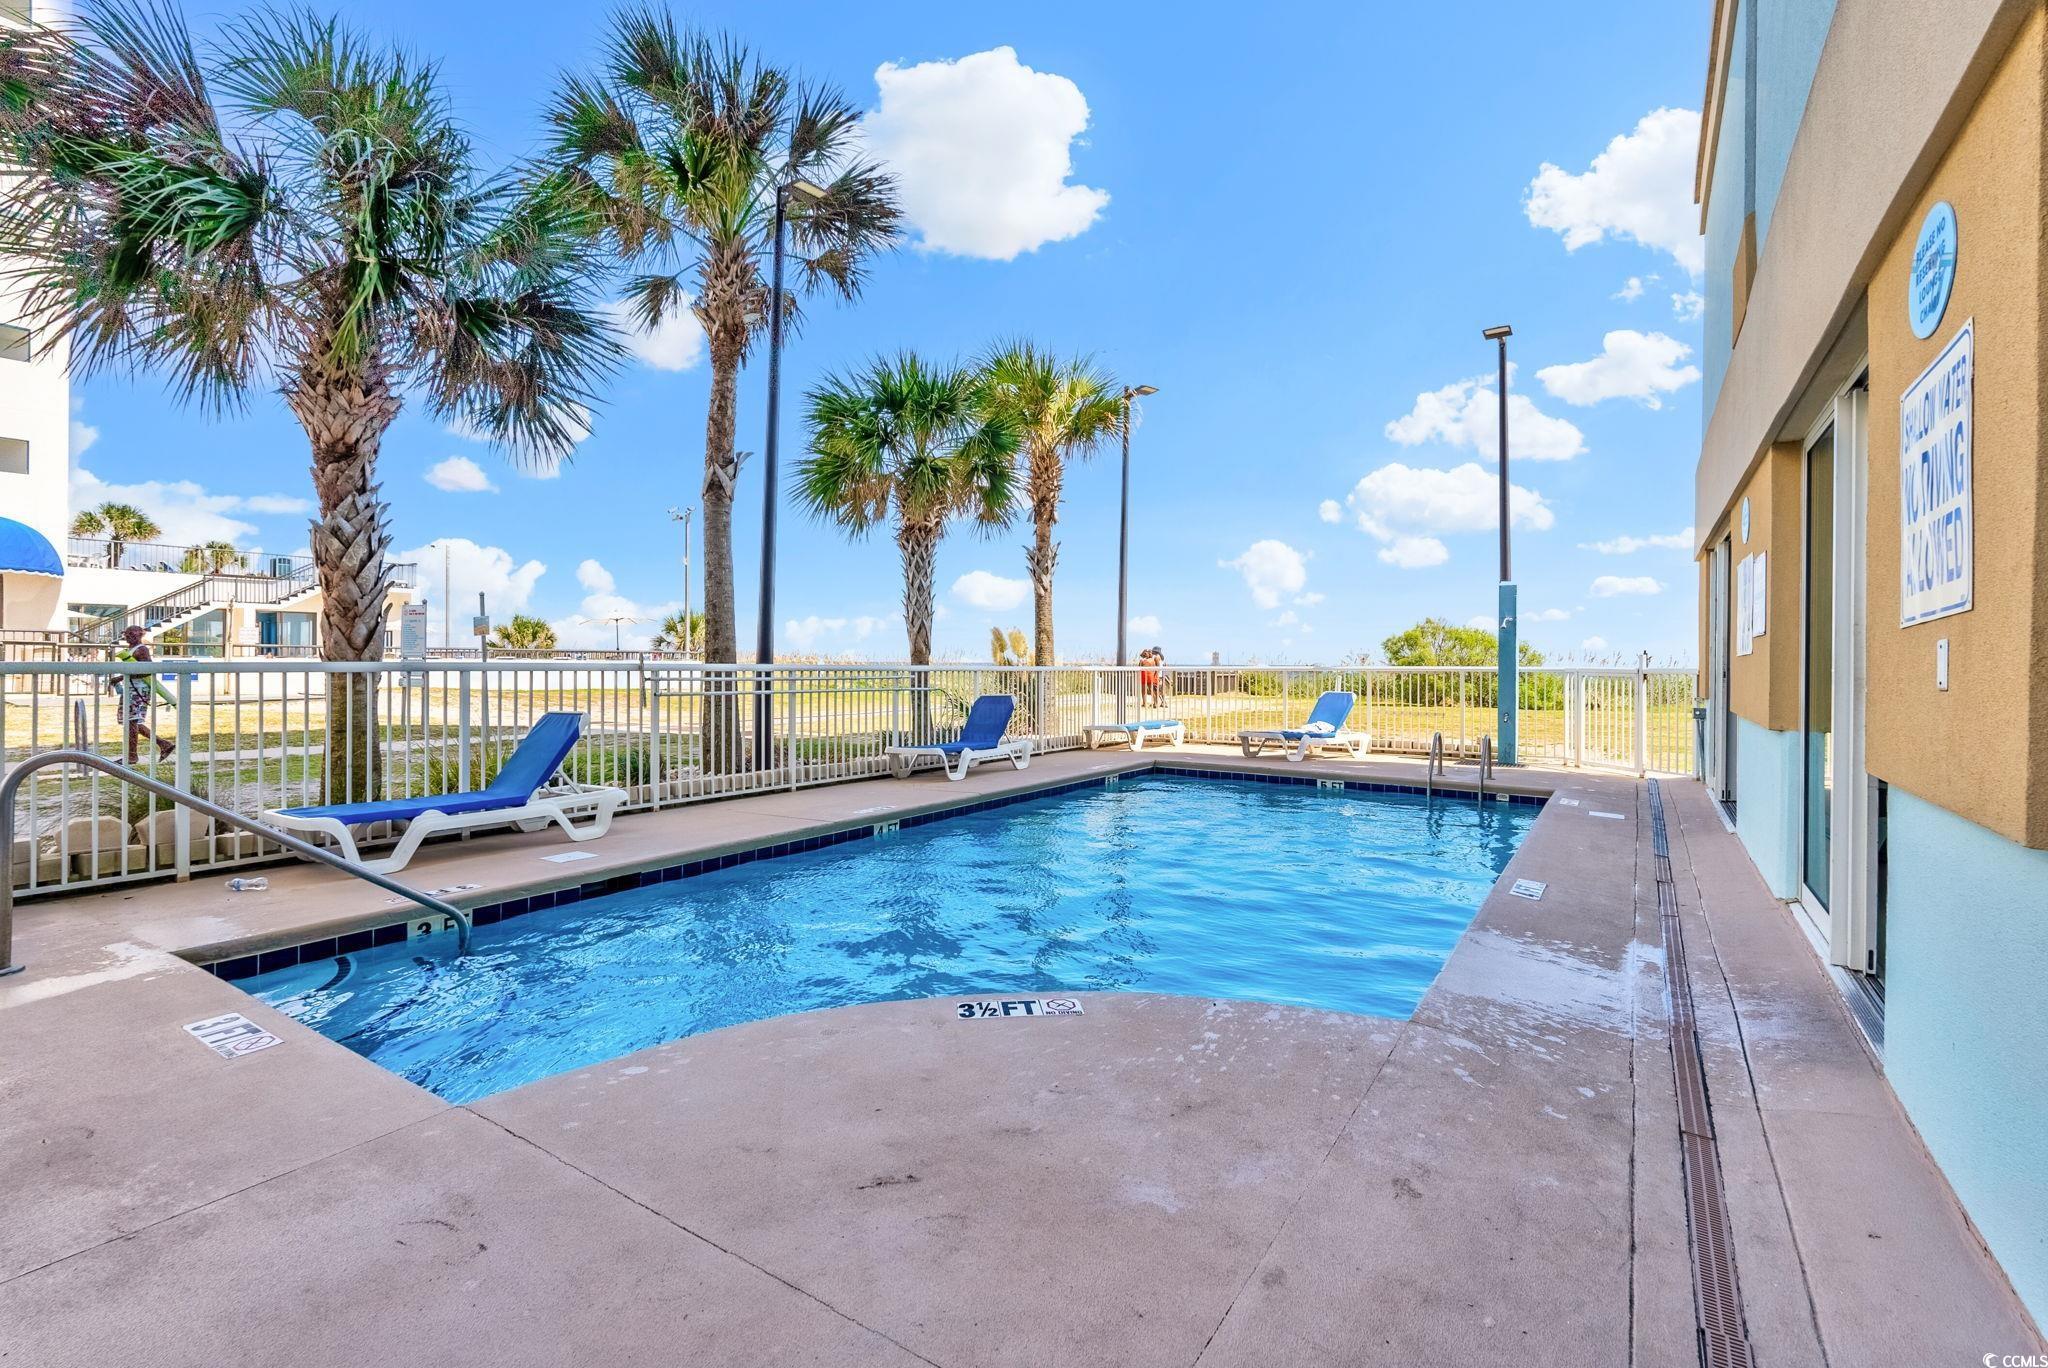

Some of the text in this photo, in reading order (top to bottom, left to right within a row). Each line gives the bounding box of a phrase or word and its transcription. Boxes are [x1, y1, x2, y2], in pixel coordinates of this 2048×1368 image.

[1936, 217, 1945, 238] NO
[1905, 420, 1964, 525] NO DIVING
[1906, 507, 1964, 598] ALLOWED
[1001, 1000, 1037, 1016] FT
[191, 1016, 263, 1044] 3 FT
